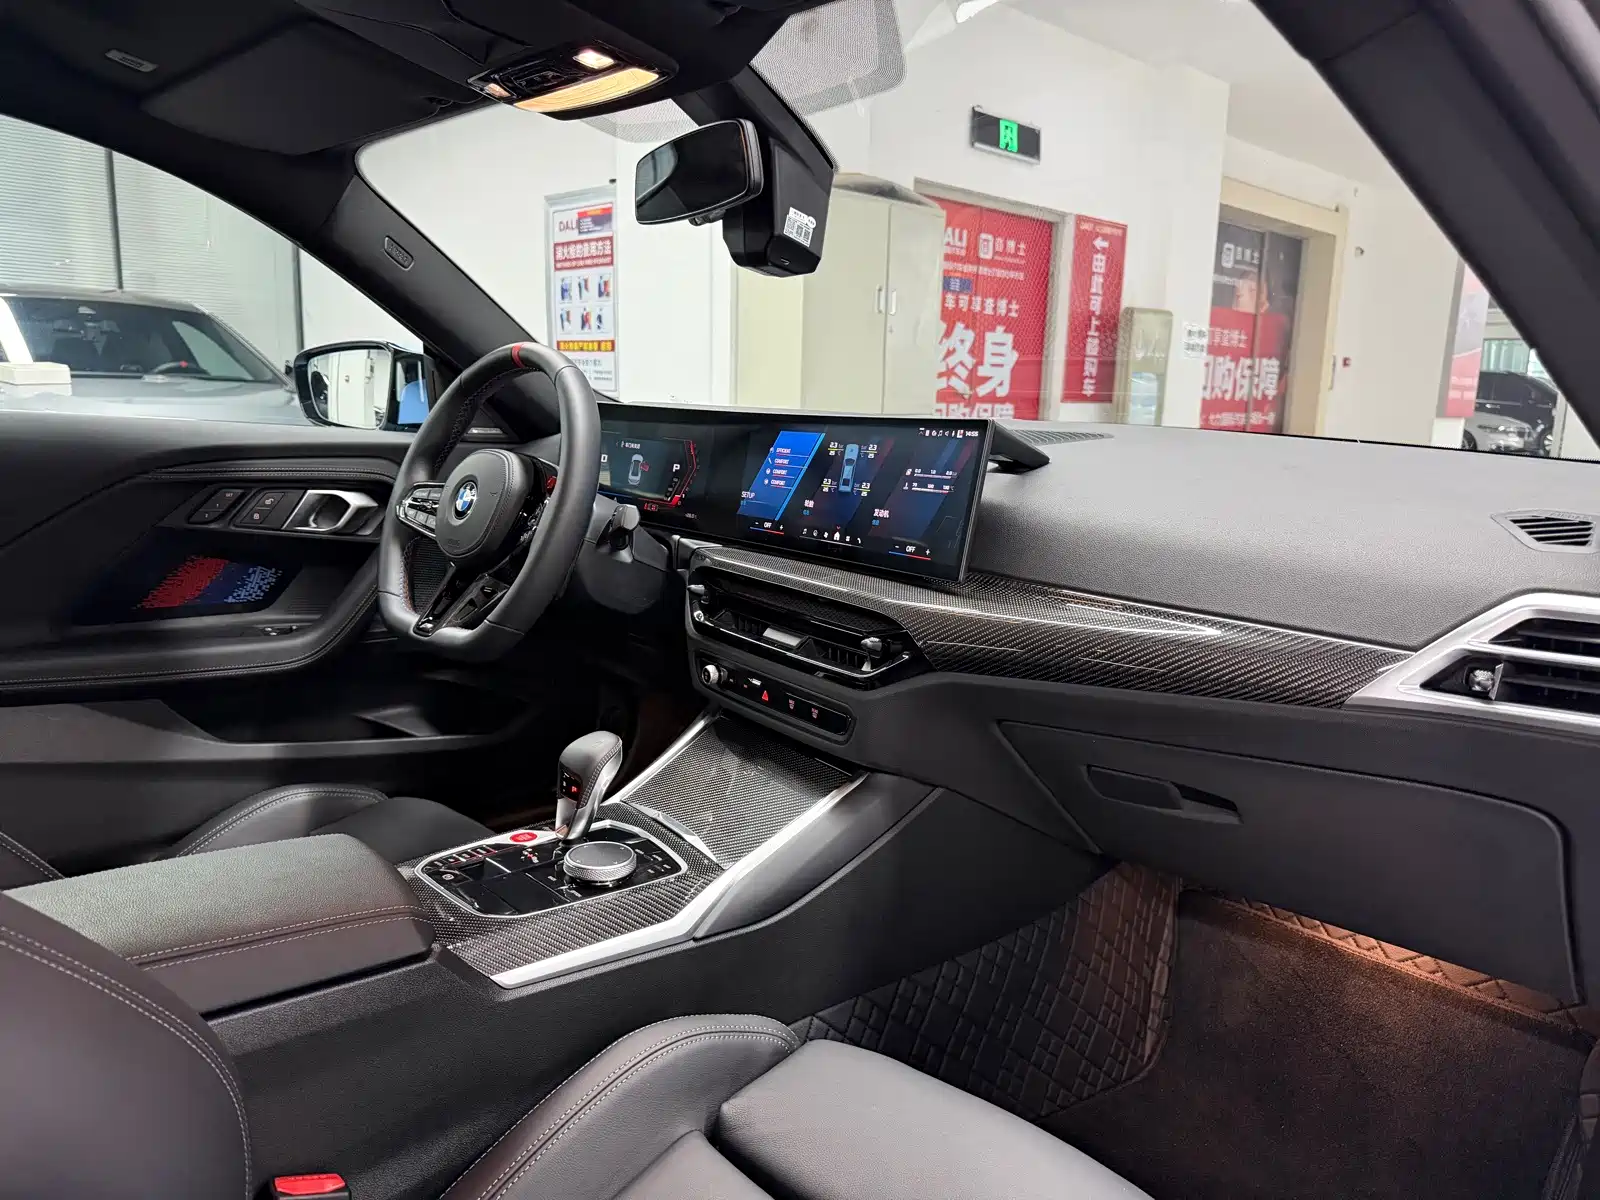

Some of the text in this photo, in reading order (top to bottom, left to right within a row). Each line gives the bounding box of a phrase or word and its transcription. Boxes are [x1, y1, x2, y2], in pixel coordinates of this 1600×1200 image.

[936, 320, 1019, 399] 终身
[672, 463, 680, 472] P
[741, 491, 755, 499] SETUP
[905, 545, 916, 553] OFF
